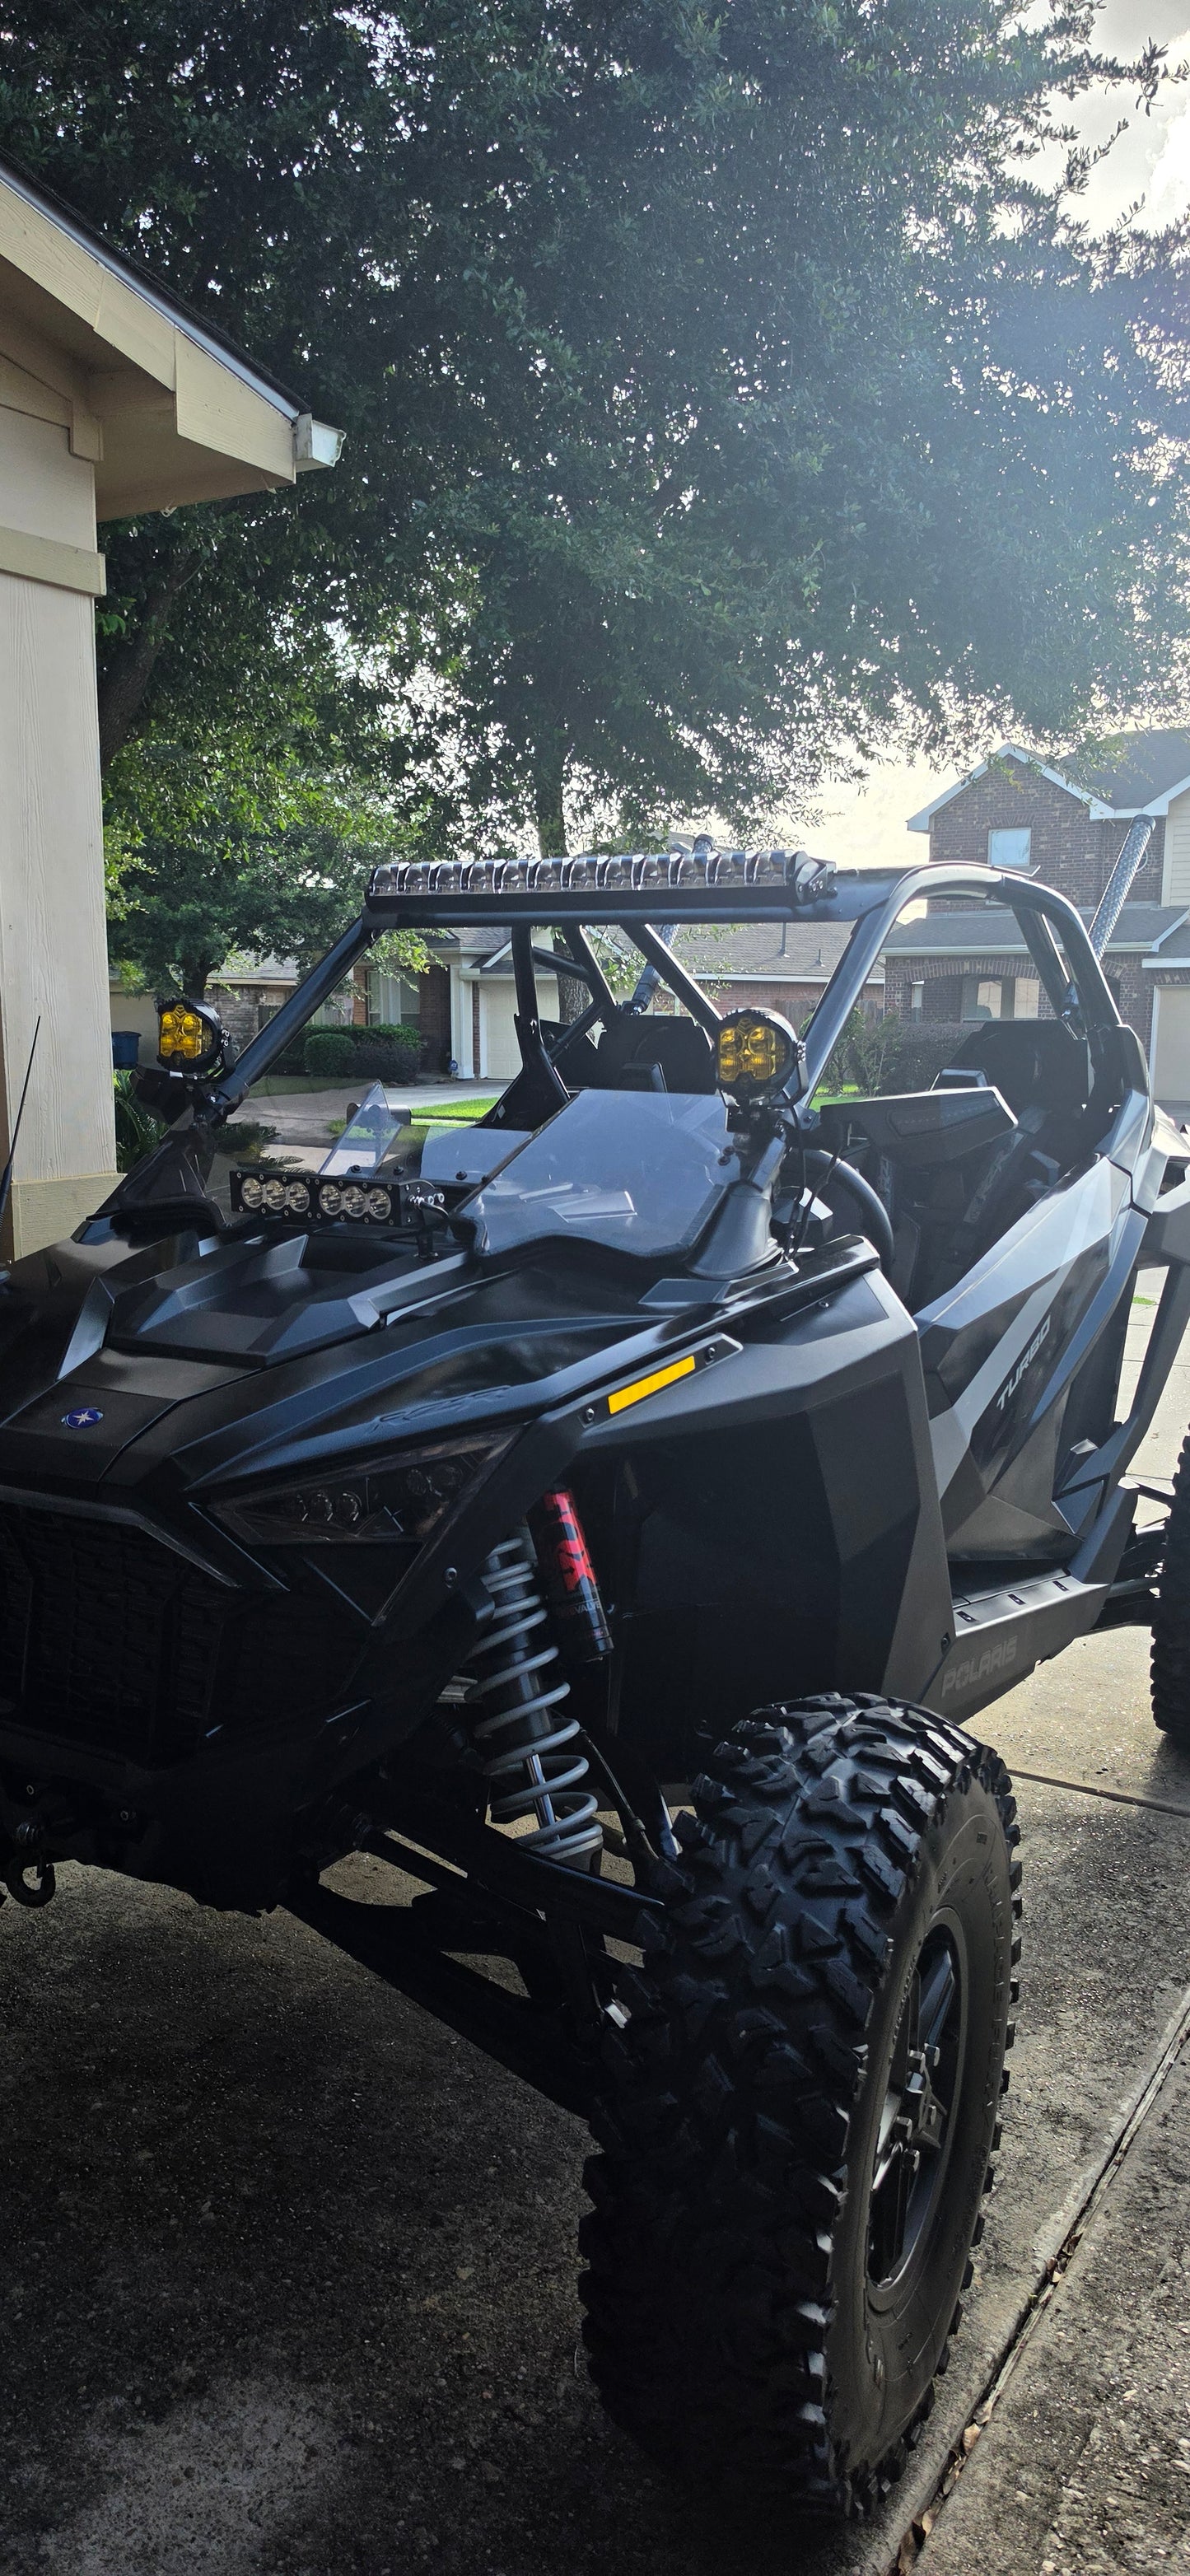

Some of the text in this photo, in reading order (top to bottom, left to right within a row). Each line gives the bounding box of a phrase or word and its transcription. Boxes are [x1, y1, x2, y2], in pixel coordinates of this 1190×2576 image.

[996, 1314, 1052, 1411] TURBO
[544, 1491, 597, 1592] FOX
[940, 1634, 1019, 1700] POLARIS
